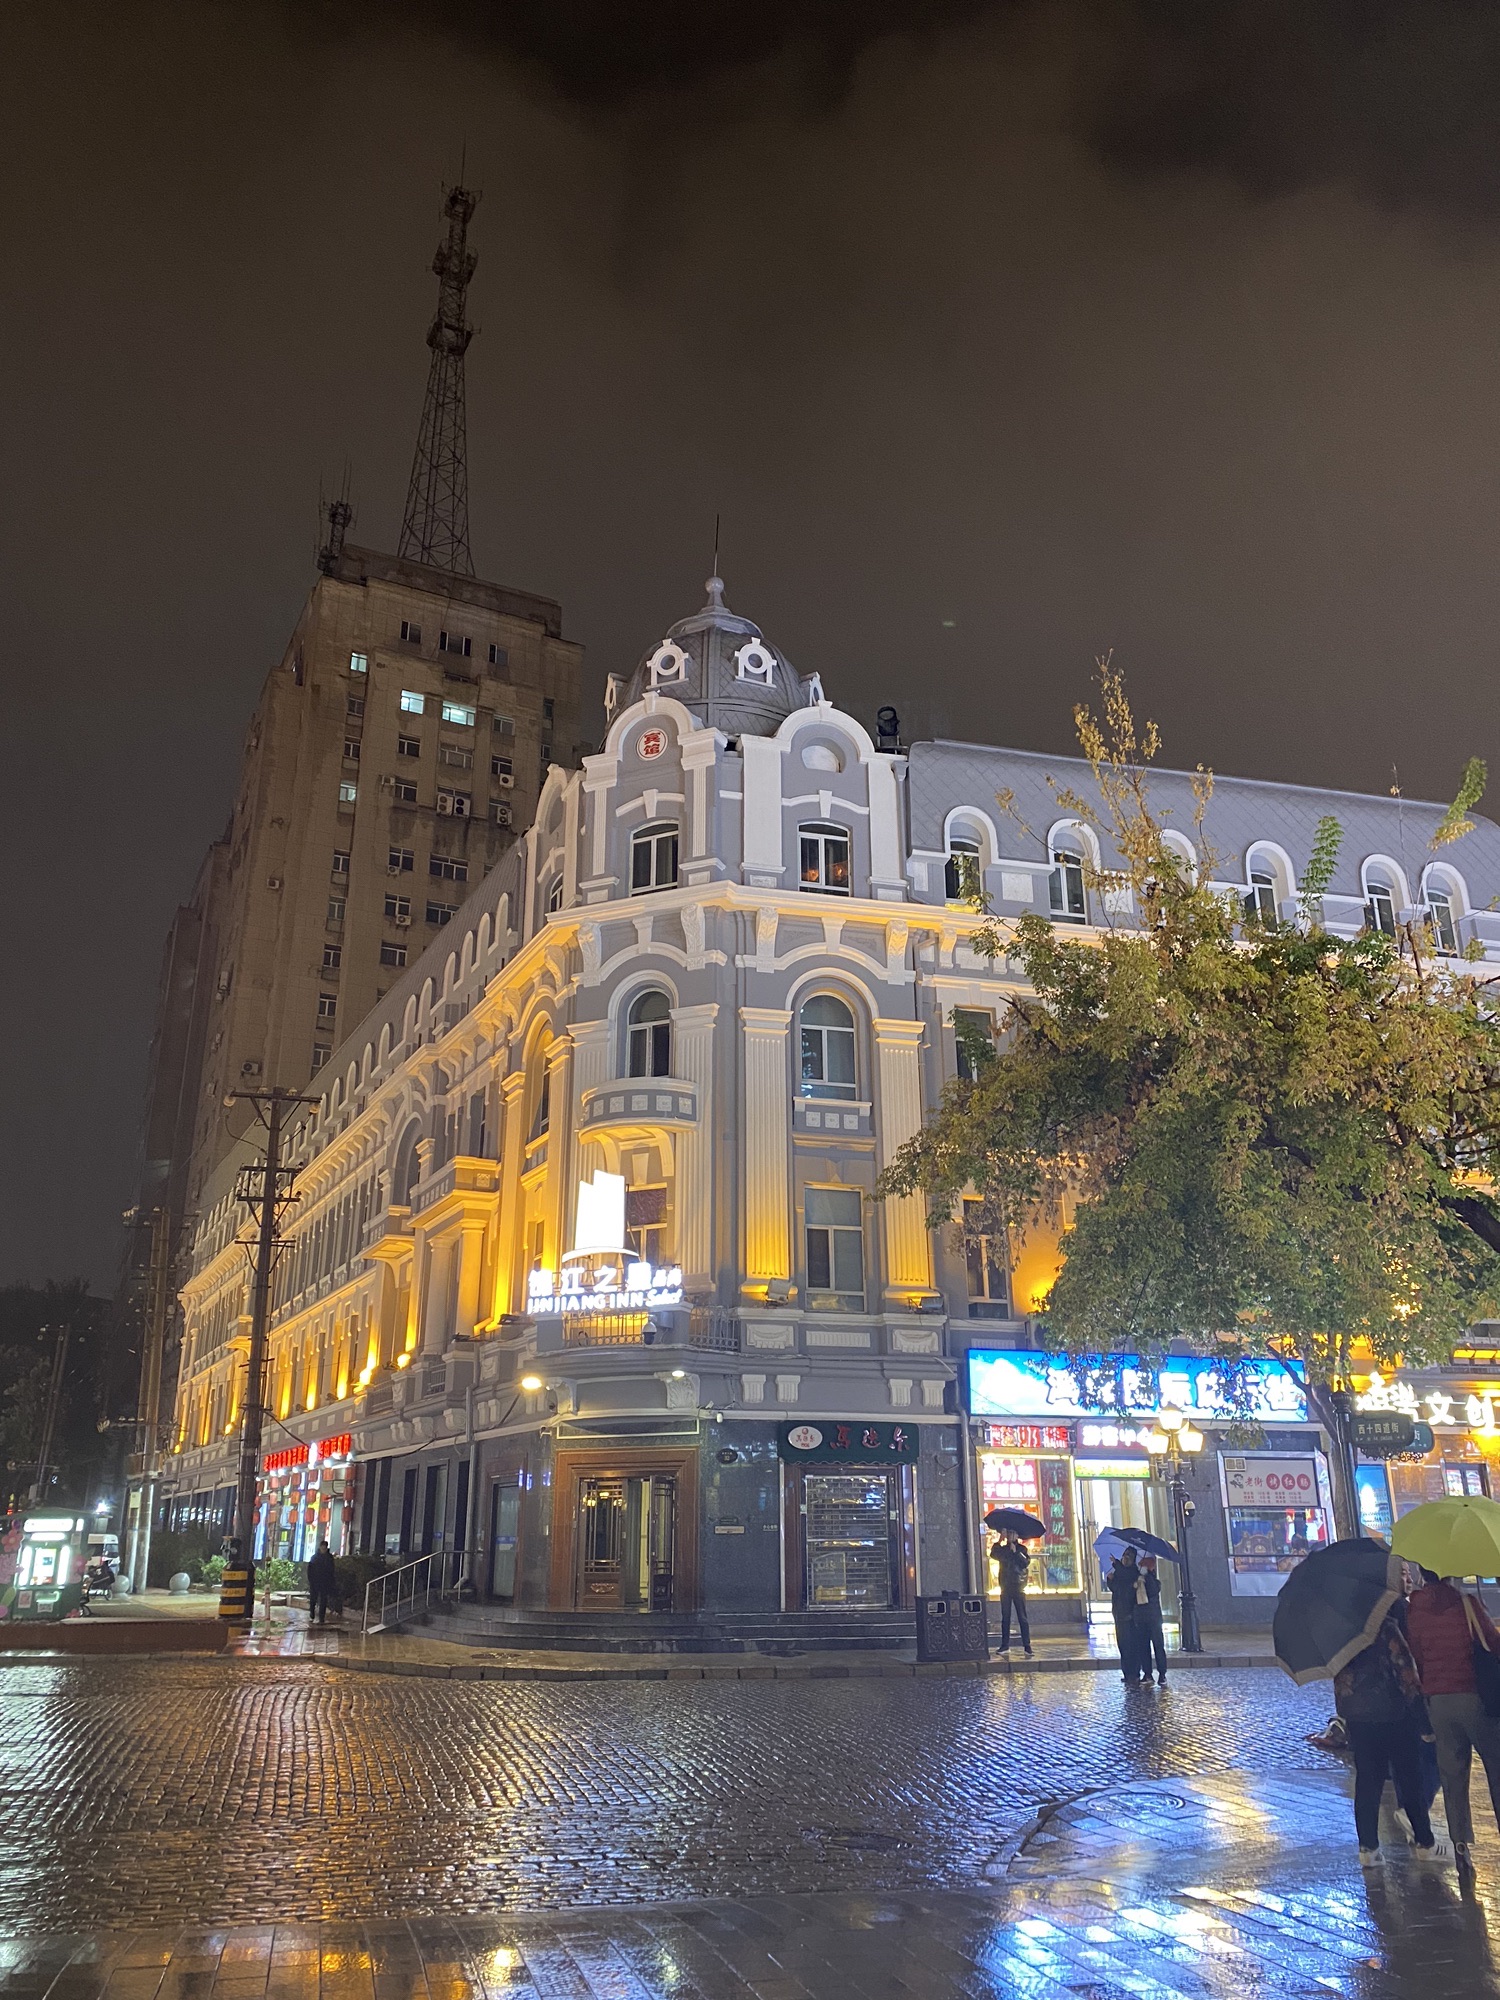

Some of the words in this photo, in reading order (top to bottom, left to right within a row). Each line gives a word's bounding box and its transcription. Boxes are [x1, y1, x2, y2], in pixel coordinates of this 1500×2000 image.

[1357, 1422, 1400, 1435] 西十四道街
